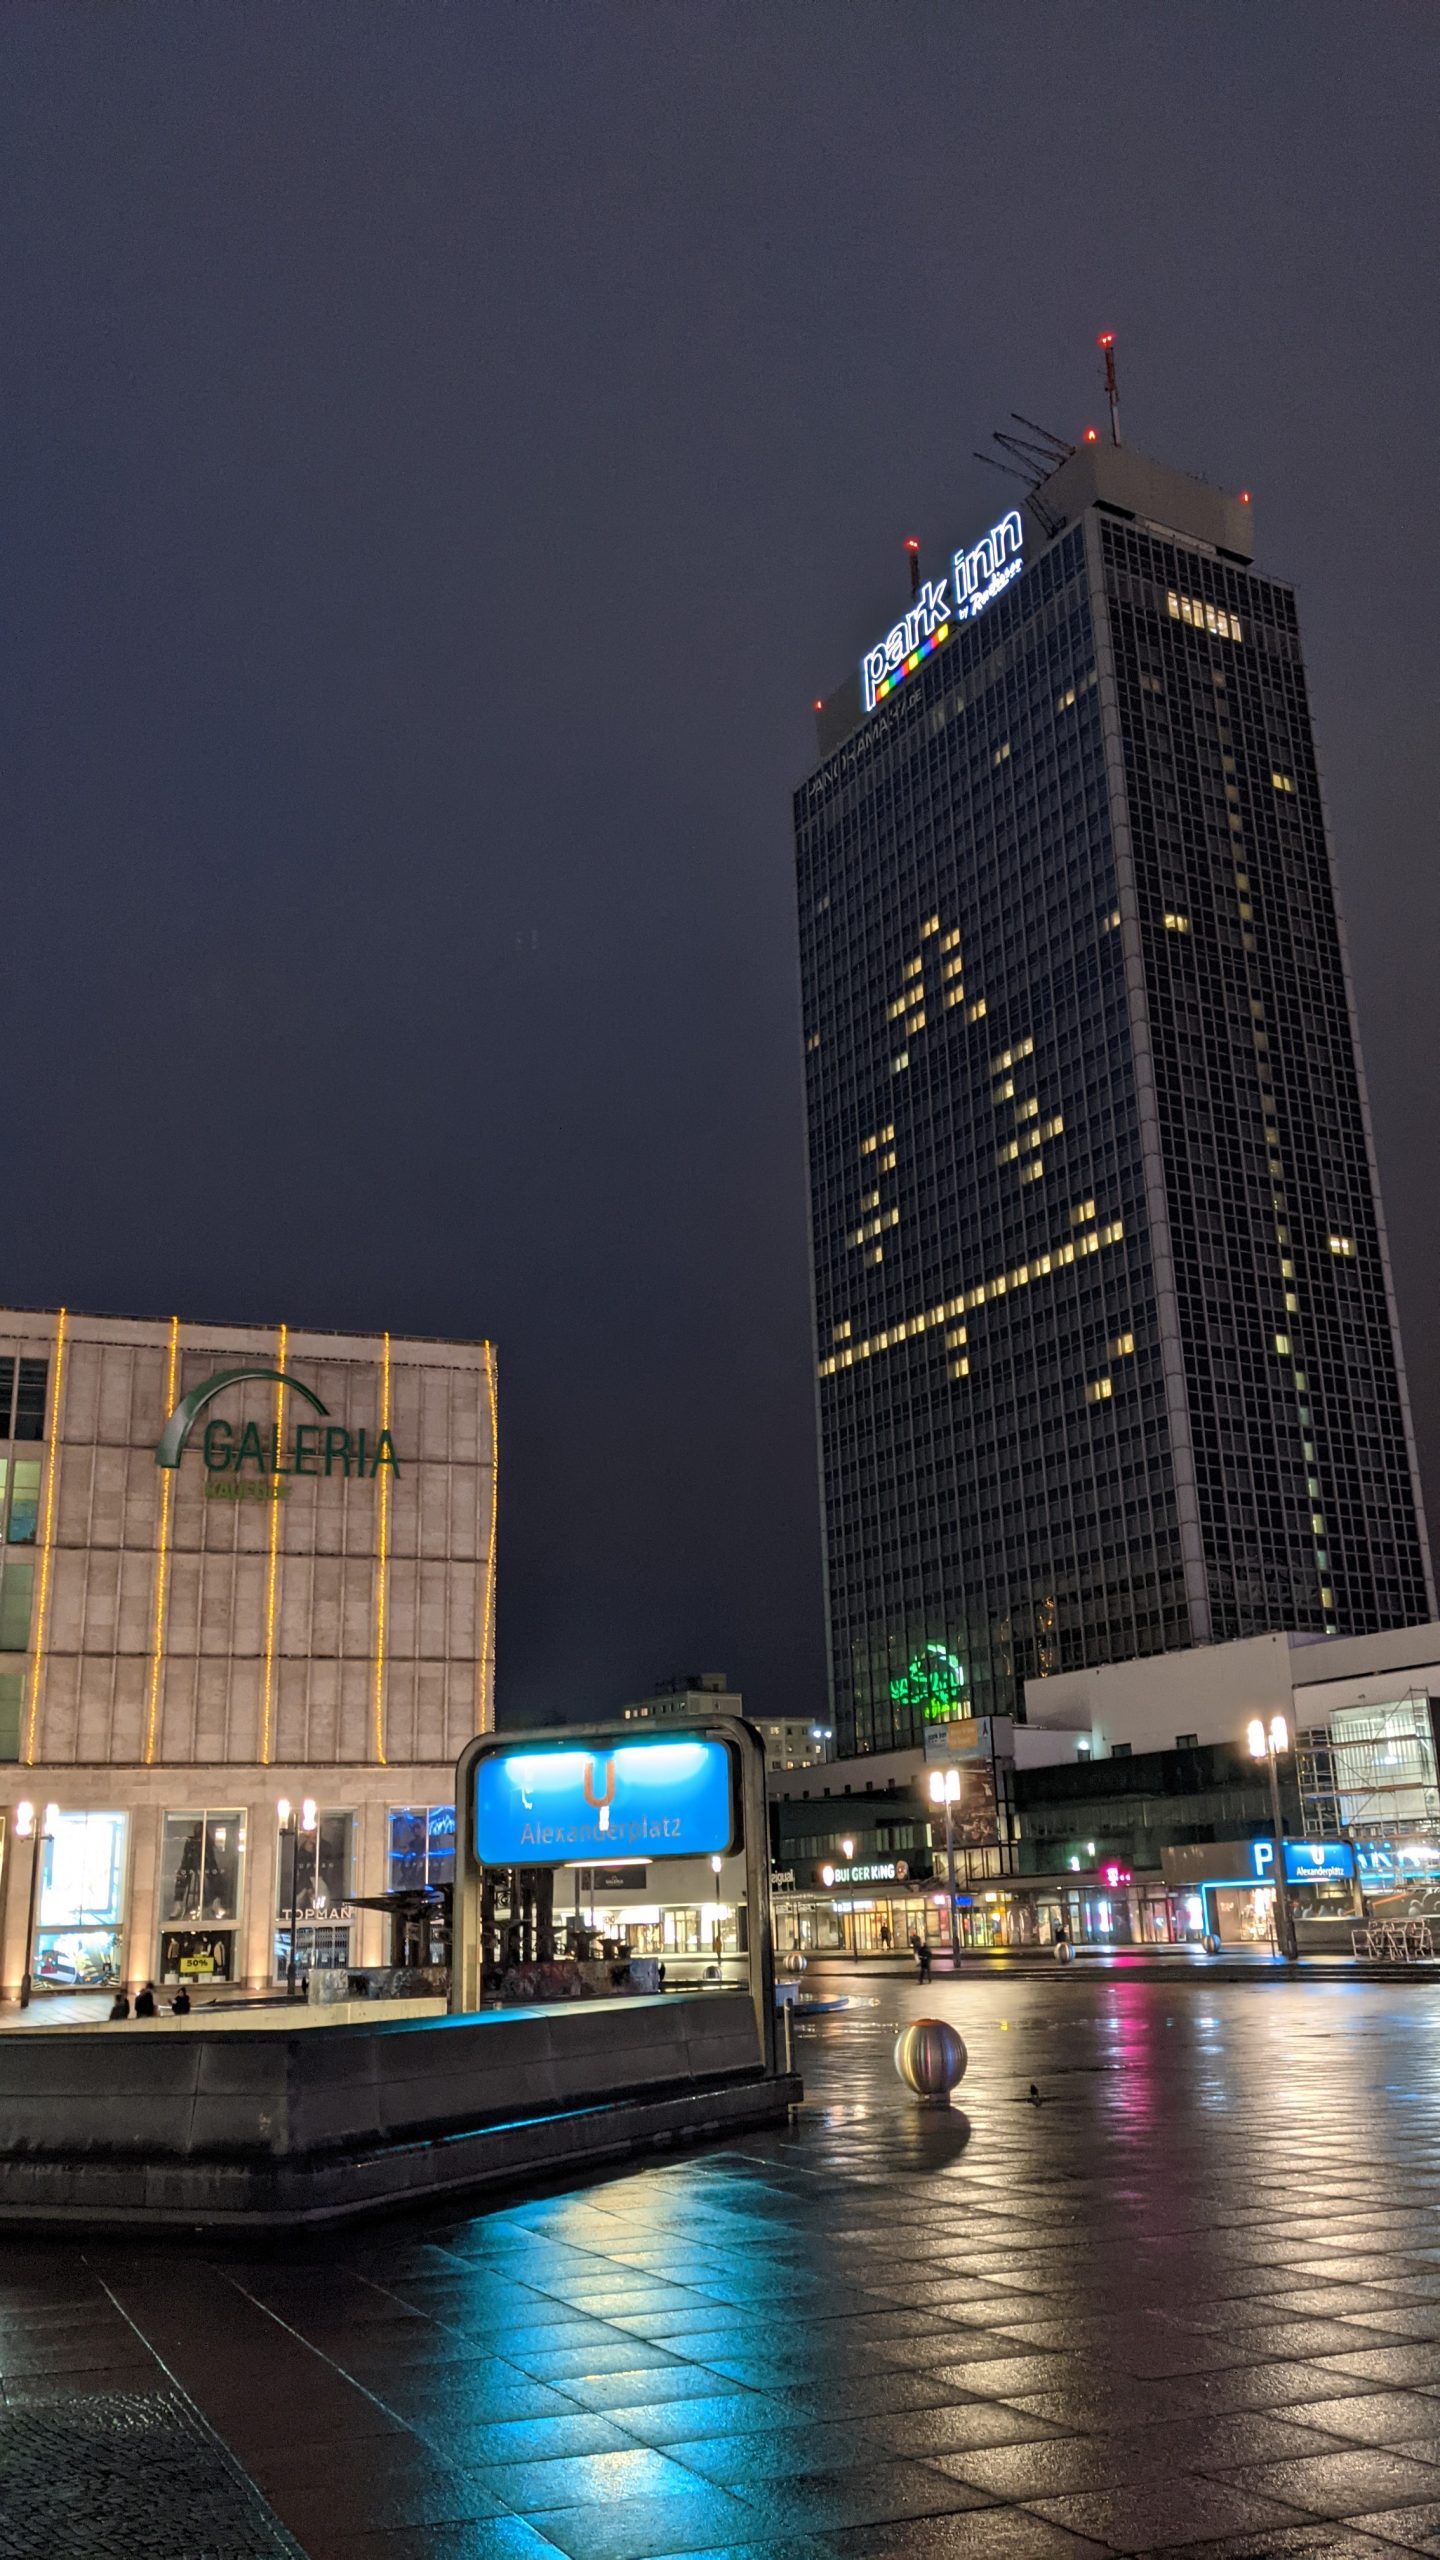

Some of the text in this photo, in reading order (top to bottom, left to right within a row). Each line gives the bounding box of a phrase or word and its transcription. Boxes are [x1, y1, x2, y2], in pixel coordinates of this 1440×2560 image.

[864, 511, 1023, 712] park inn
[203, 1418, 401, 1479] GALERIA
[583, 1757, 615, 1808] U
[521, 1816, 682, 1846] Alexanderplatz
[1311, 1845, 1325, 1866] U
[871, 1864, 895, 1880] KING
[1296, 1866, 1345, 1878] Alexanderplatz
[282, 1907, 352, 1920] TOPMAN
[187, 1958, 209, 1968] 50%
